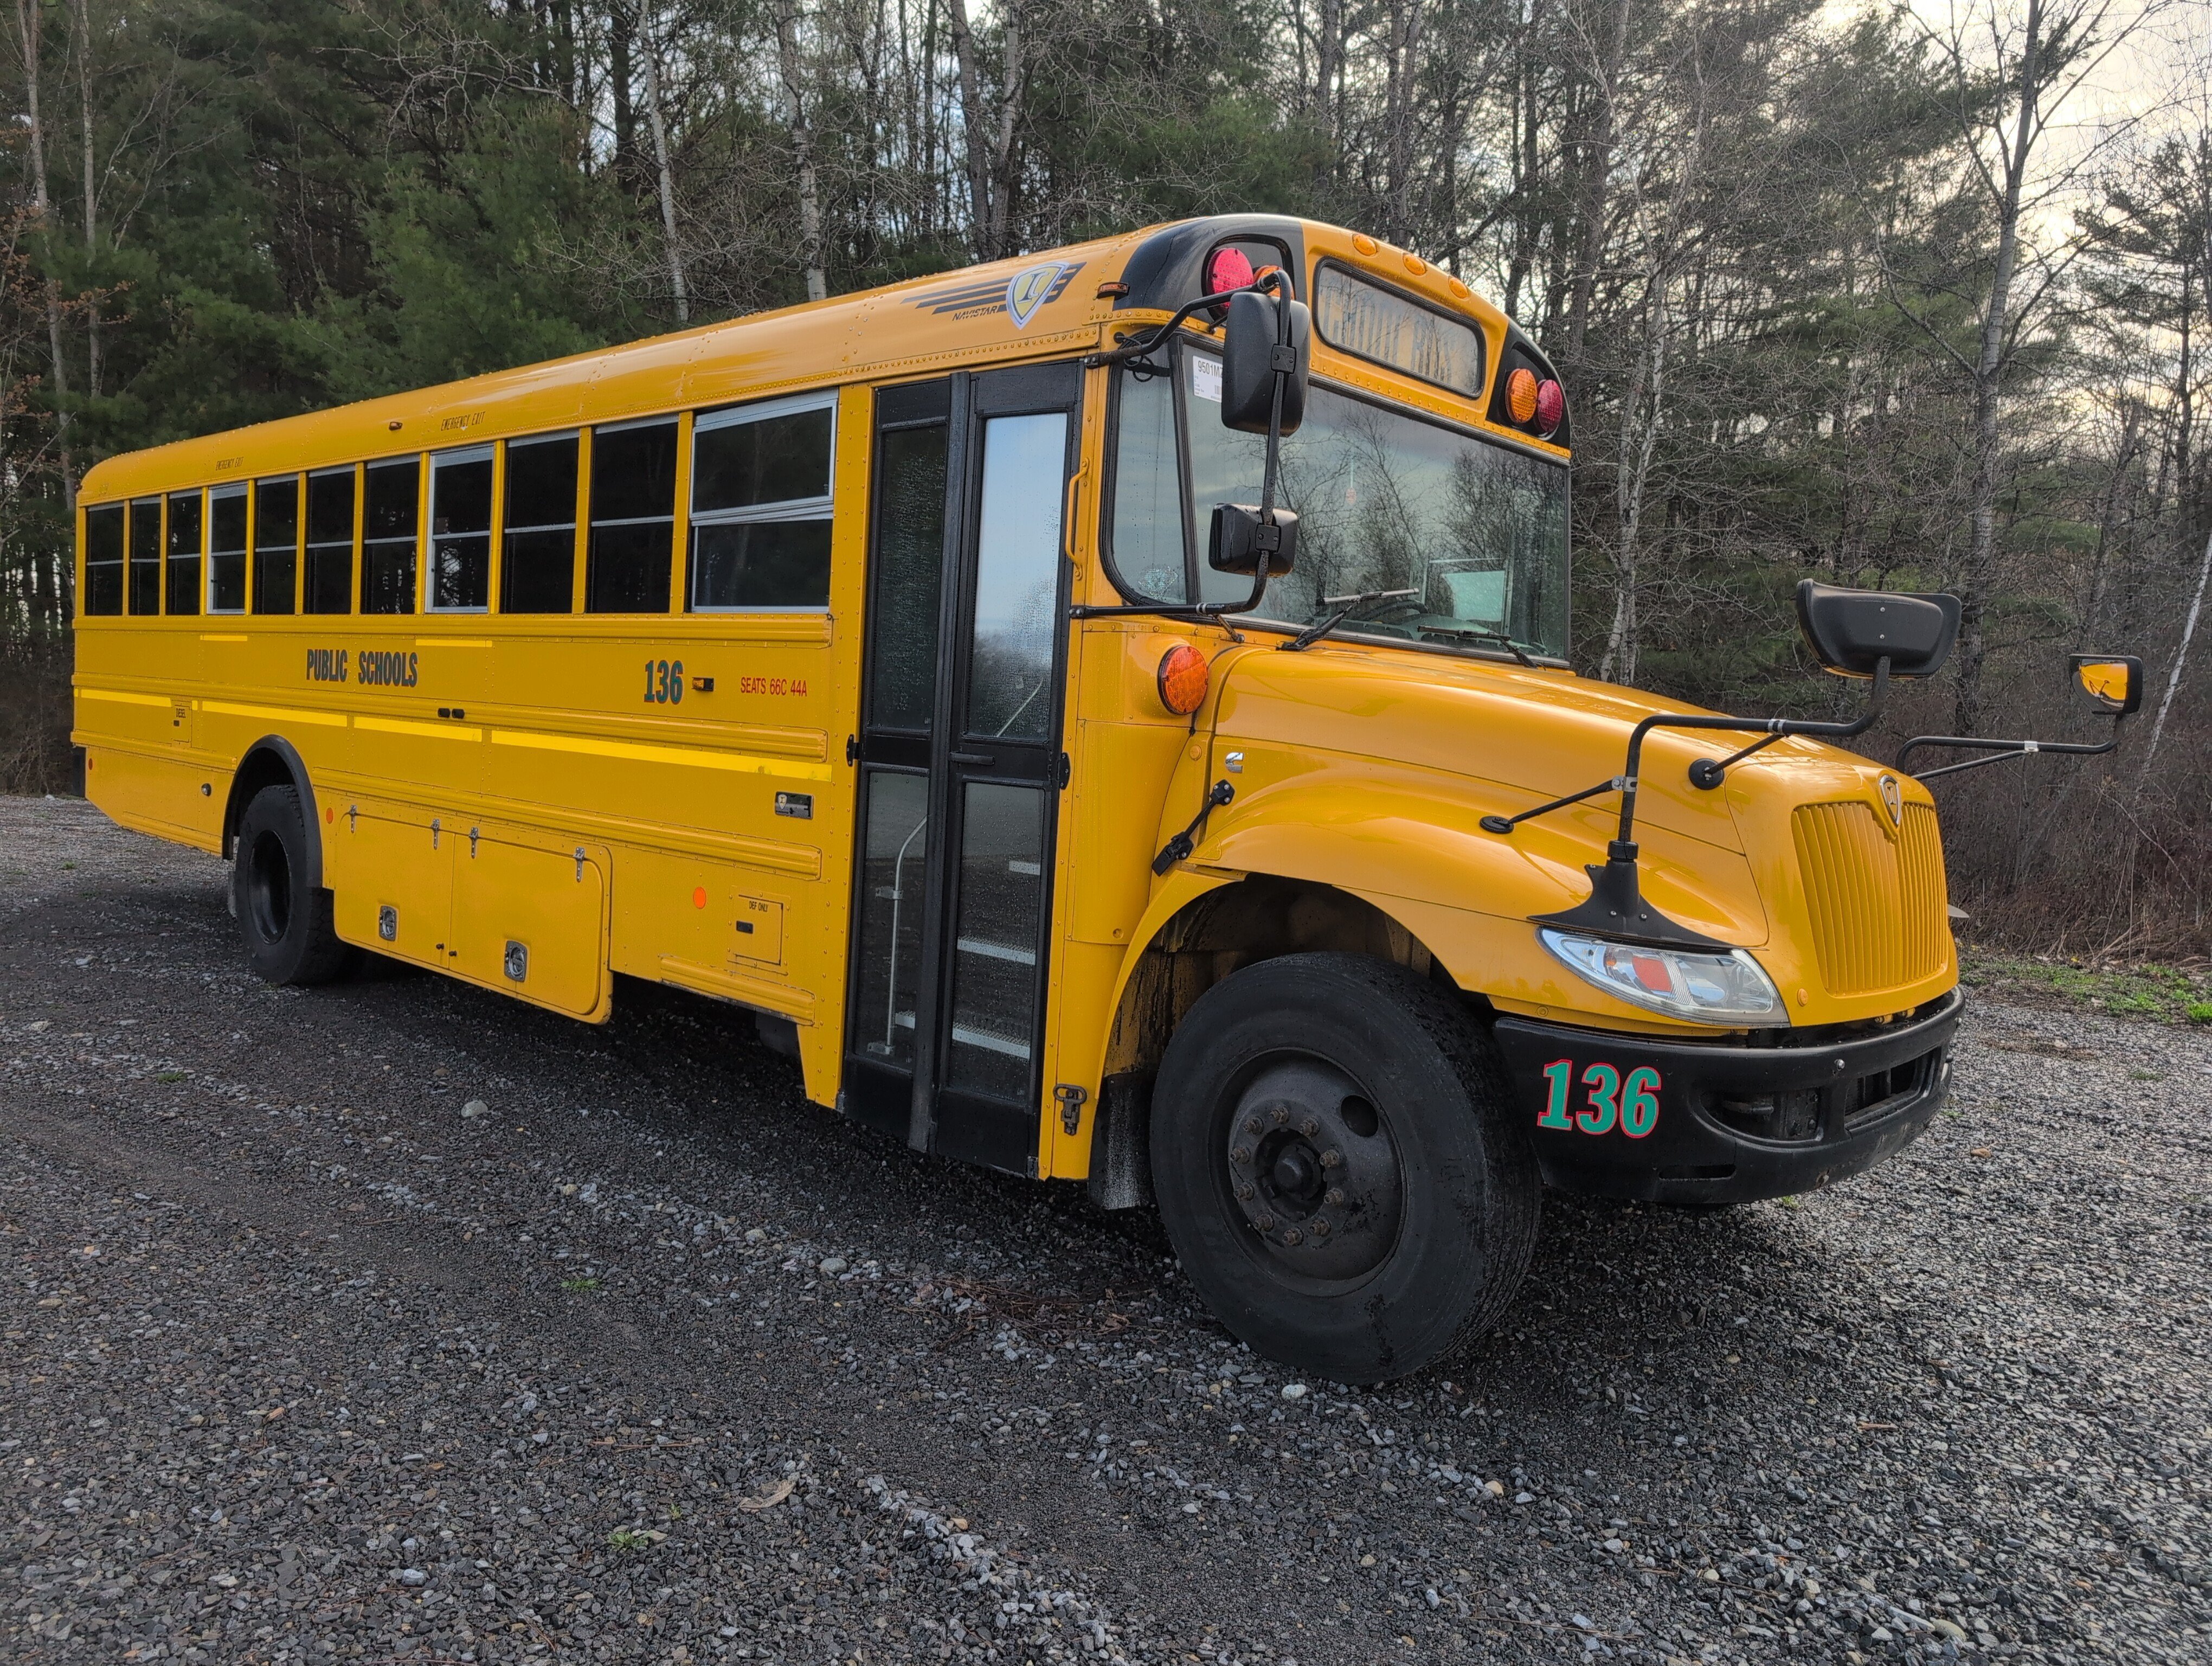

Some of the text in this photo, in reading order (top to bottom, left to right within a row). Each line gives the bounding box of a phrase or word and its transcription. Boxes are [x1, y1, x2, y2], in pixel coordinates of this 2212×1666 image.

[952, 305, 998, 321] NAVISTAR
[441, 411, 486, 431] EMERGENCY EXIT
[306, 649, 418, 688] PUBLIC SCHOOLS
[644, 659, 683, 705] 136
[741, 677, 808, 697] SEATS 66C 44A
[749, 900, 769, 913] DEF ONLY
[1536, 1059, 1662, 1139] 136
